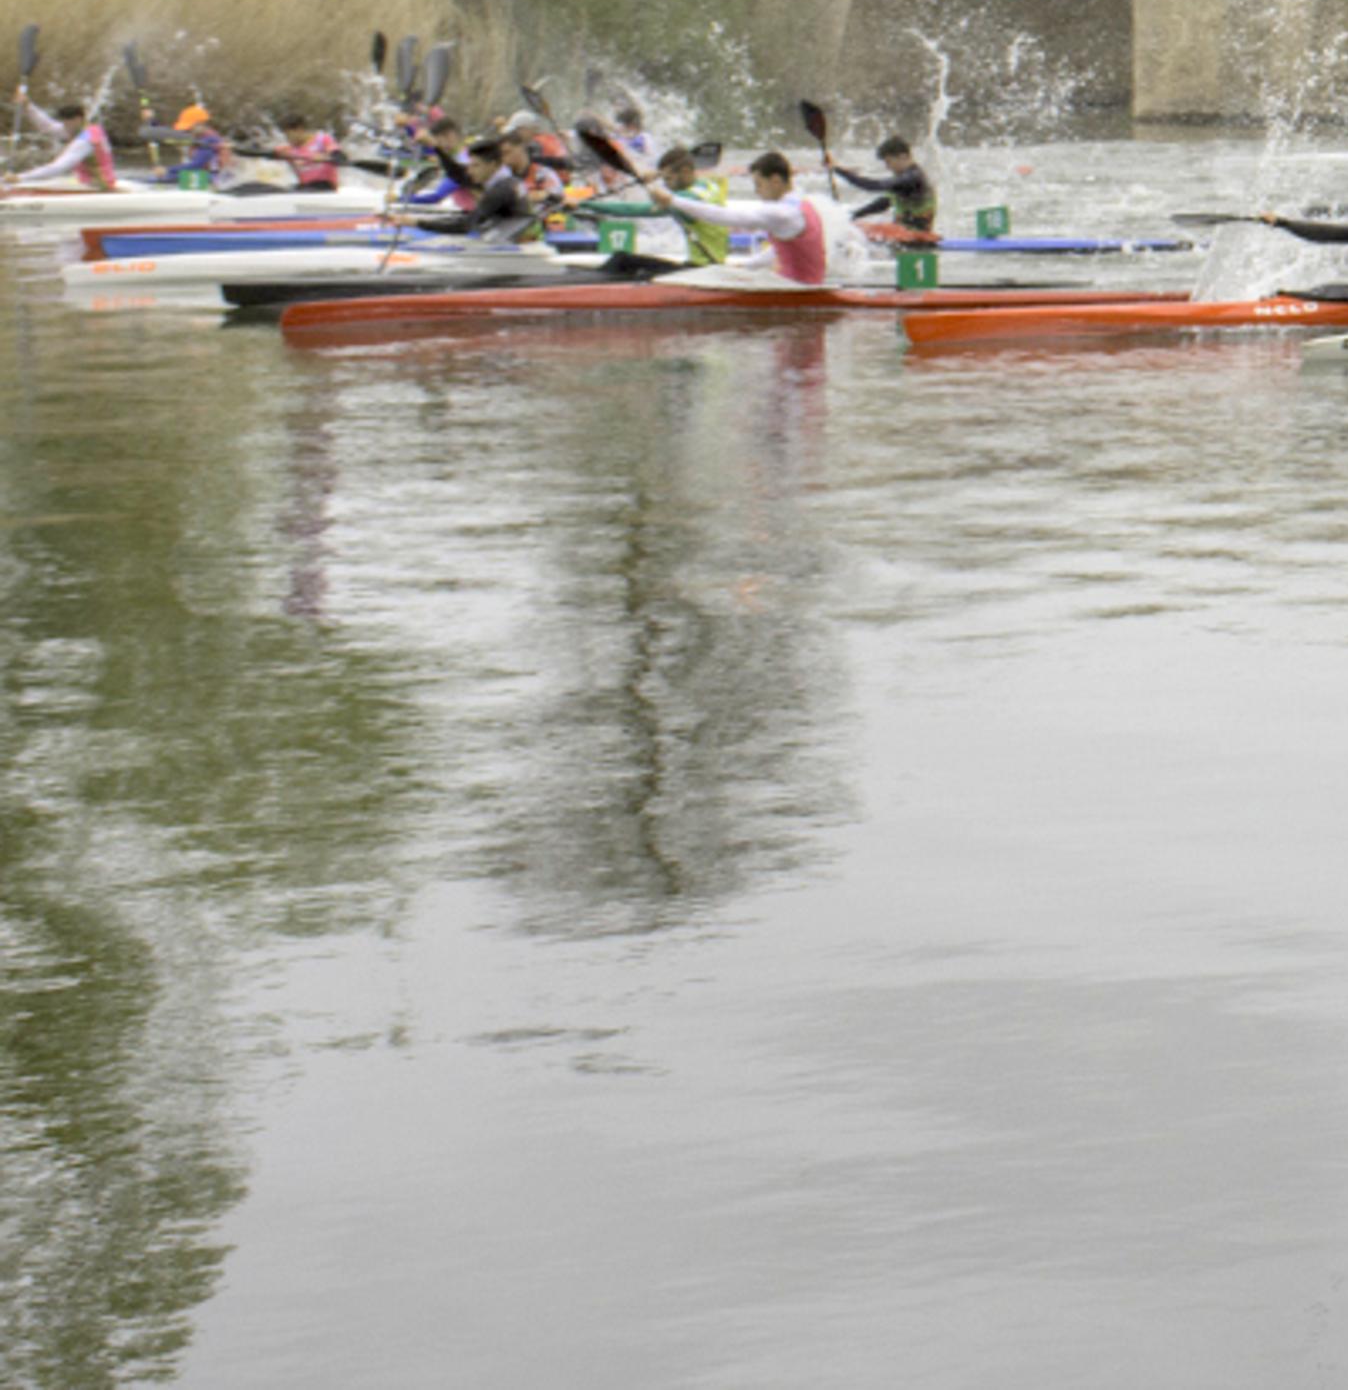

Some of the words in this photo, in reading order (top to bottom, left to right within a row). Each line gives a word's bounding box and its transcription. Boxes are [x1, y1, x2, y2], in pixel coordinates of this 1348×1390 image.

[608, 229, 629, 249] 17
[915, 259, 925, 282] 1
[1253, 302, 1318, 315] NELO
